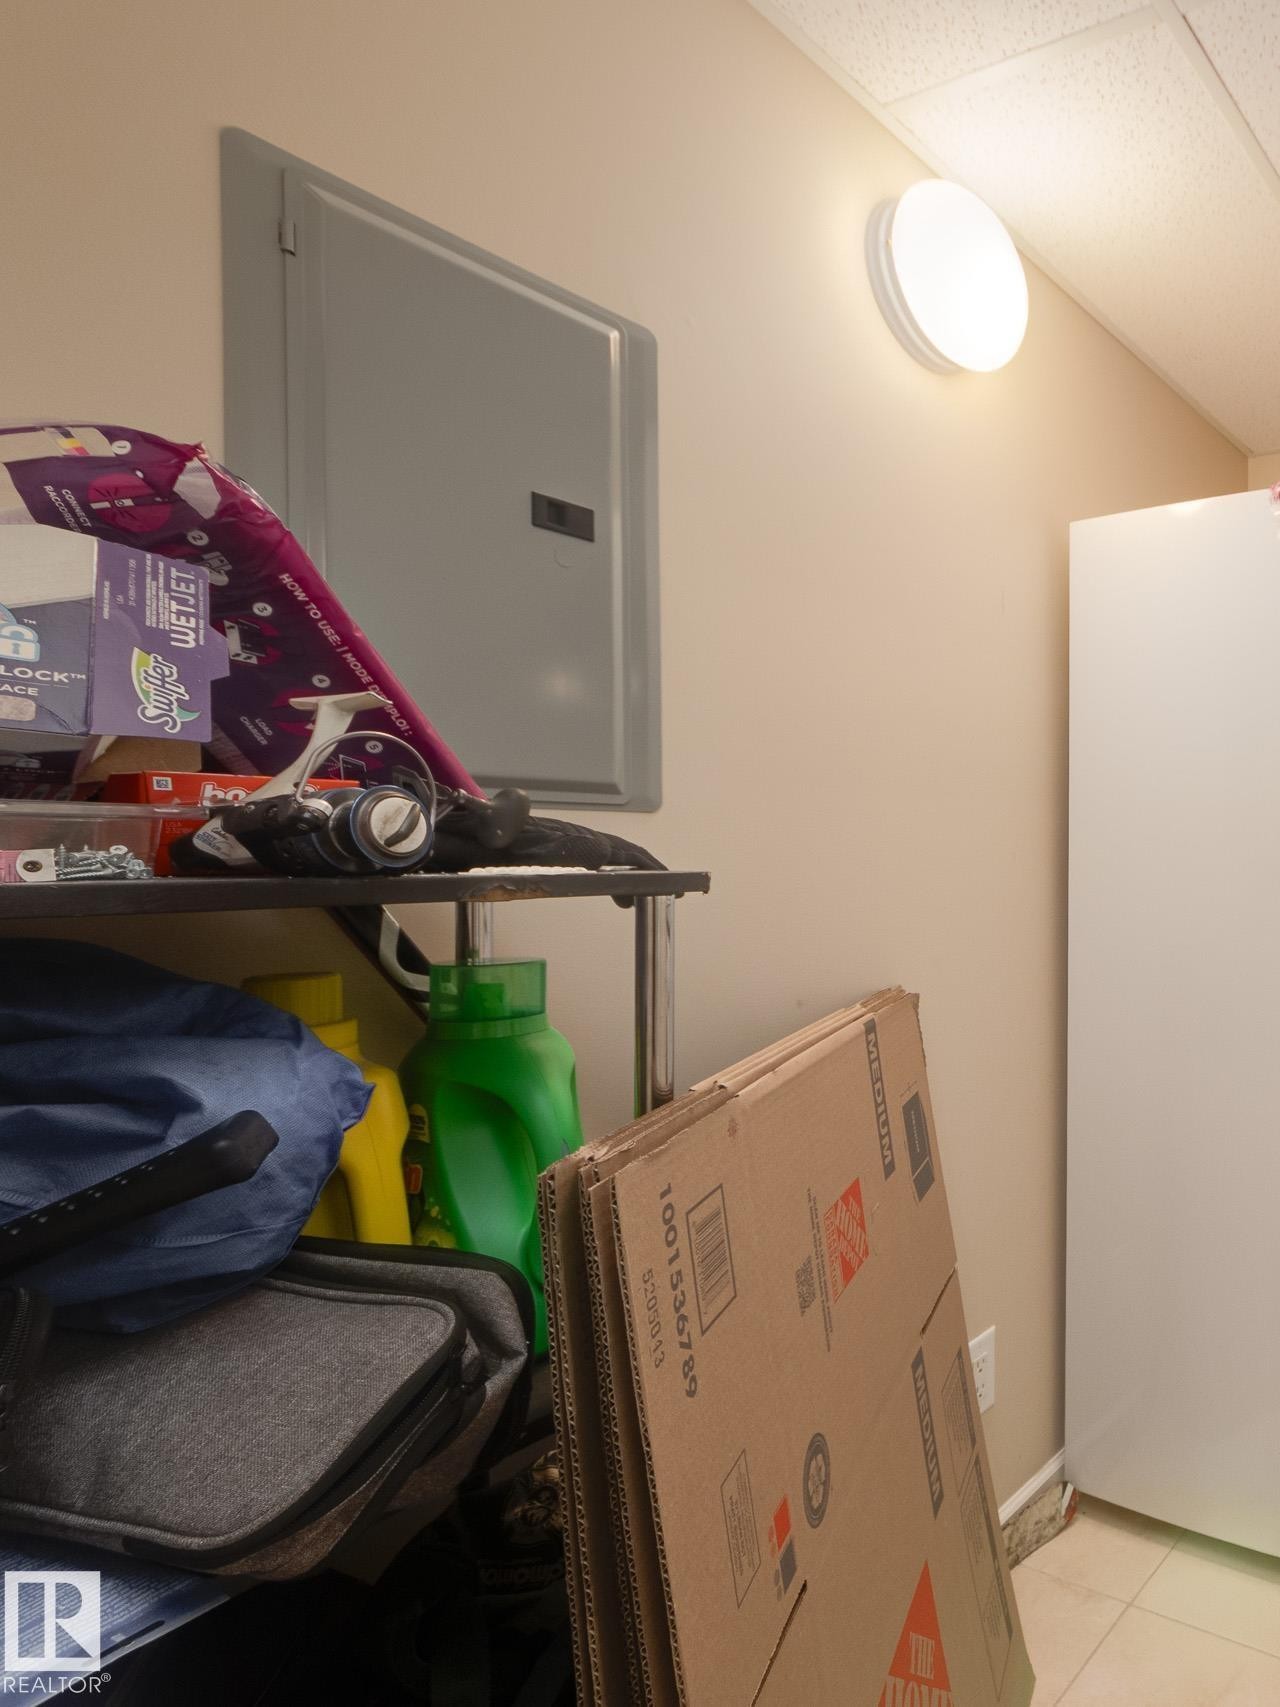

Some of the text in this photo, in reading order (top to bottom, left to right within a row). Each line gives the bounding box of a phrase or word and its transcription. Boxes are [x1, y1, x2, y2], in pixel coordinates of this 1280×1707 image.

[61, 488, 93, 528] CONNECT
[170, 567, 196, 649] WETJET
[278, 573, 309, 602] HOW
[304, 602, 322, 620] TO
[341, 652, 374, 688] MODE
[138, 653, 190, 733] Swiffer
[239, 716, 268, 745] CHARGER
[255, 718, 273, 737] LOAD
[866, 1033, 893, 1167] MEDIUM
[913, 1364, 942, 1504] MEDIUM
